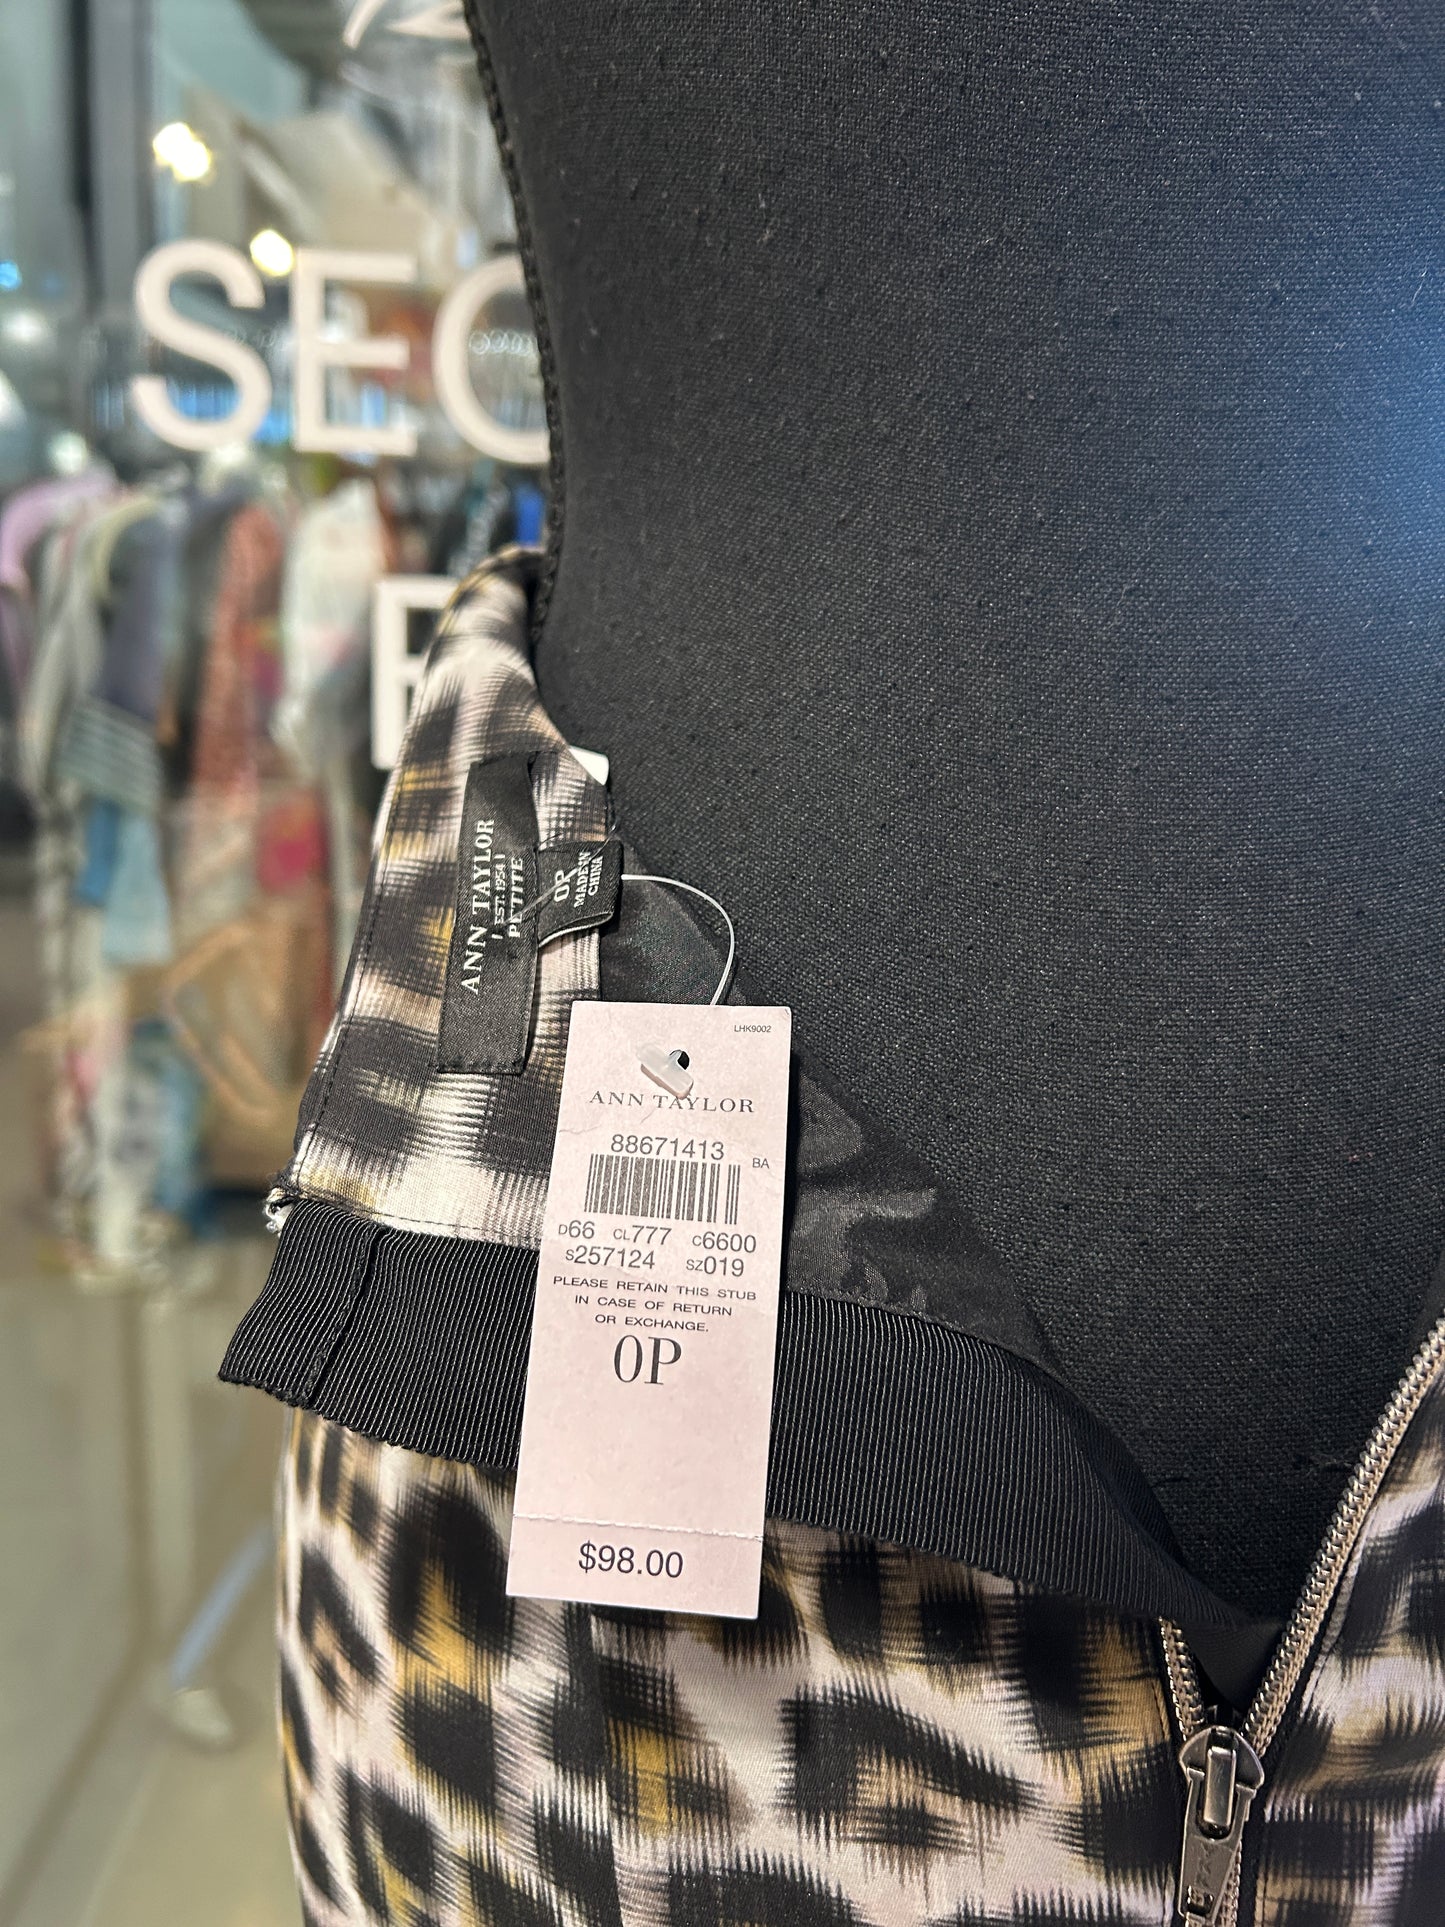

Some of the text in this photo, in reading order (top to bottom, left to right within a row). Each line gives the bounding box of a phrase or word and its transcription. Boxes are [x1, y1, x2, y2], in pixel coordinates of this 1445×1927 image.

[573, 865, 590, 908] MADE
[588, 856, 603, 896] CHINA
[460, 819, 495, 995] ANN TAYLOR
[494, 894, 506, 926] EST.
[508, 856, 524, 938] PETITE
[734, 1024, 772, 1034] LHK9002
[590, 1091, 754, 1113] ANN TAYLOR
[611, 1134, 725, 1160] 88671413
[752, 1158, 770, 1169] BA
[558, 1220, 757, 1254] D66 CL777 C6600
[565, 1245, 745, 1277] S257124 SZ019
[553, 1276, 756, 1300] PLEASE RETAIN THIS STUB
[575, 1295, 732, 1316] IN CASE OF RETURN
[595, 1314, 709, 1332] OR EXCHANGE.
[578, 1540, 684, 1579] $98.00
